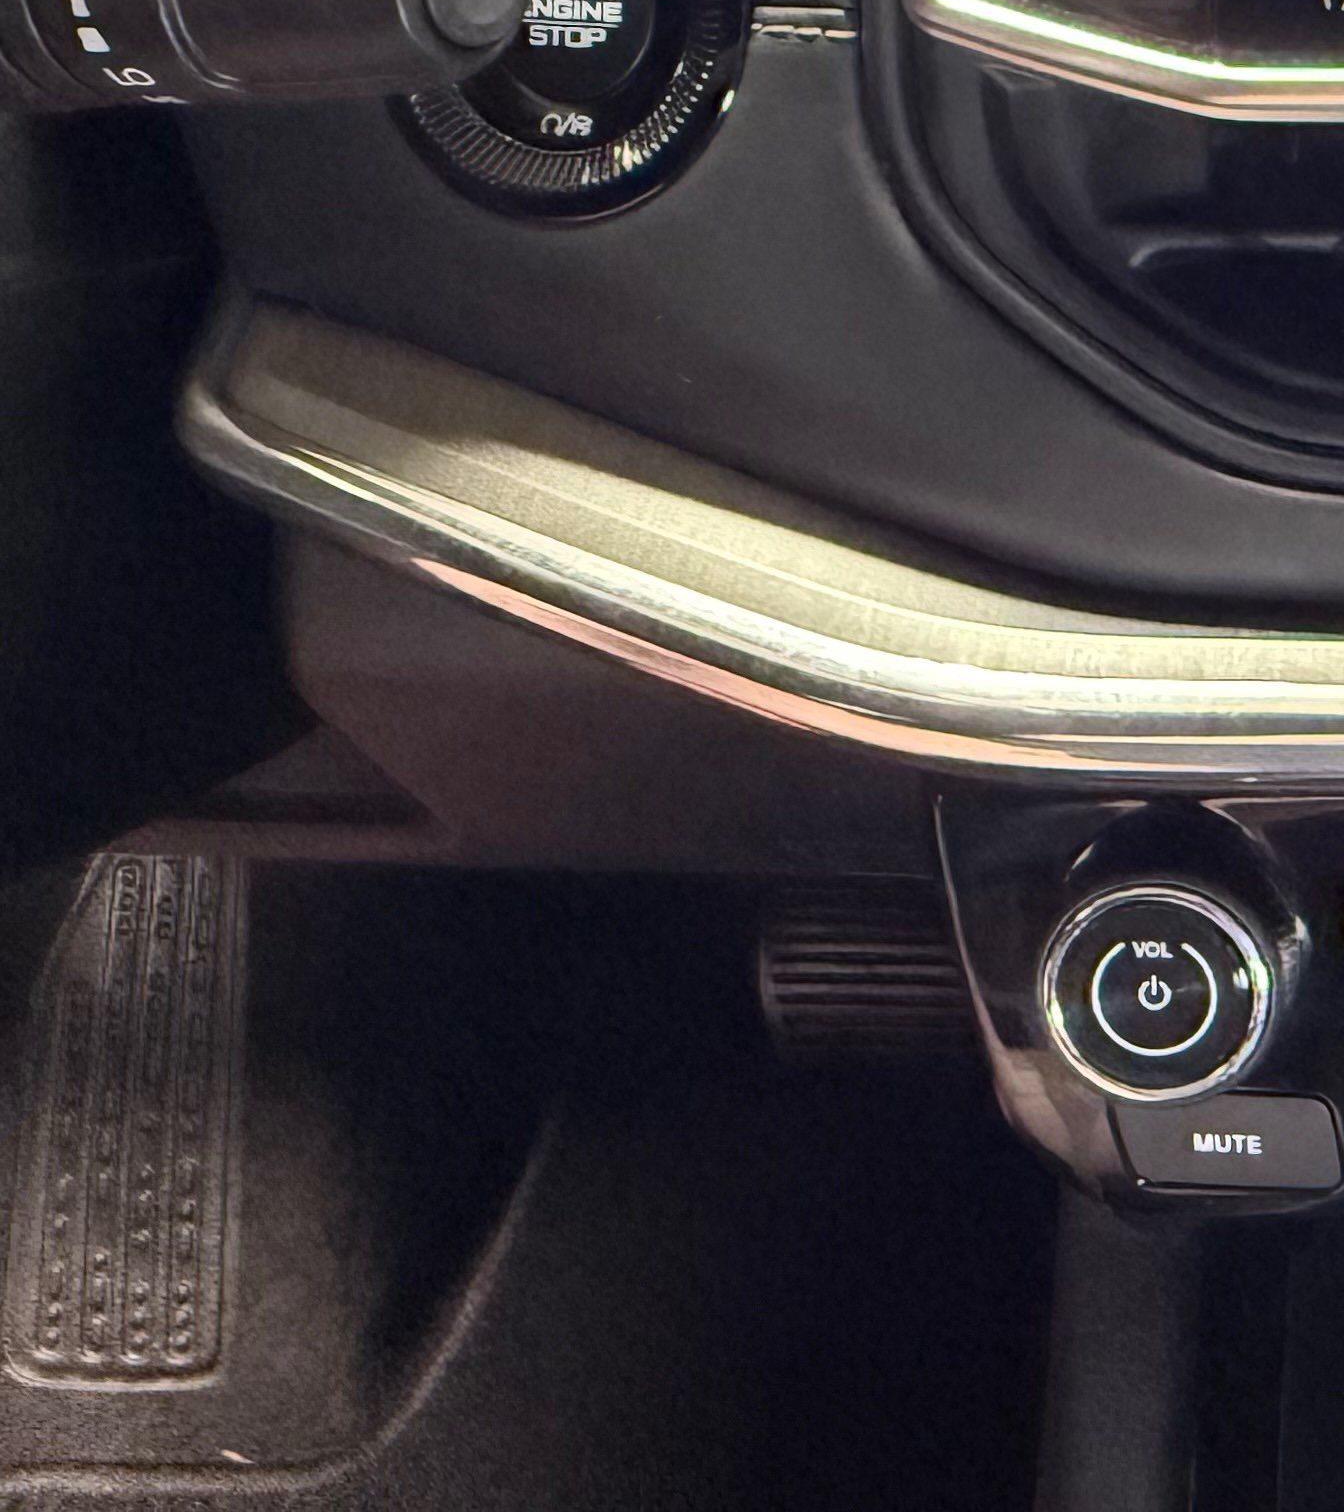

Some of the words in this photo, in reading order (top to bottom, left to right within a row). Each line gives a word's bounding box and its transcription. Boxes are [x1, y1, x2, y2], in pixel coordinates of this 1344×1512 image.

[529, 25, 607, 48] STOP
[1132, 941, 1173, 958] VOL
[1194, 1133, 1262, 1154] MUTE
